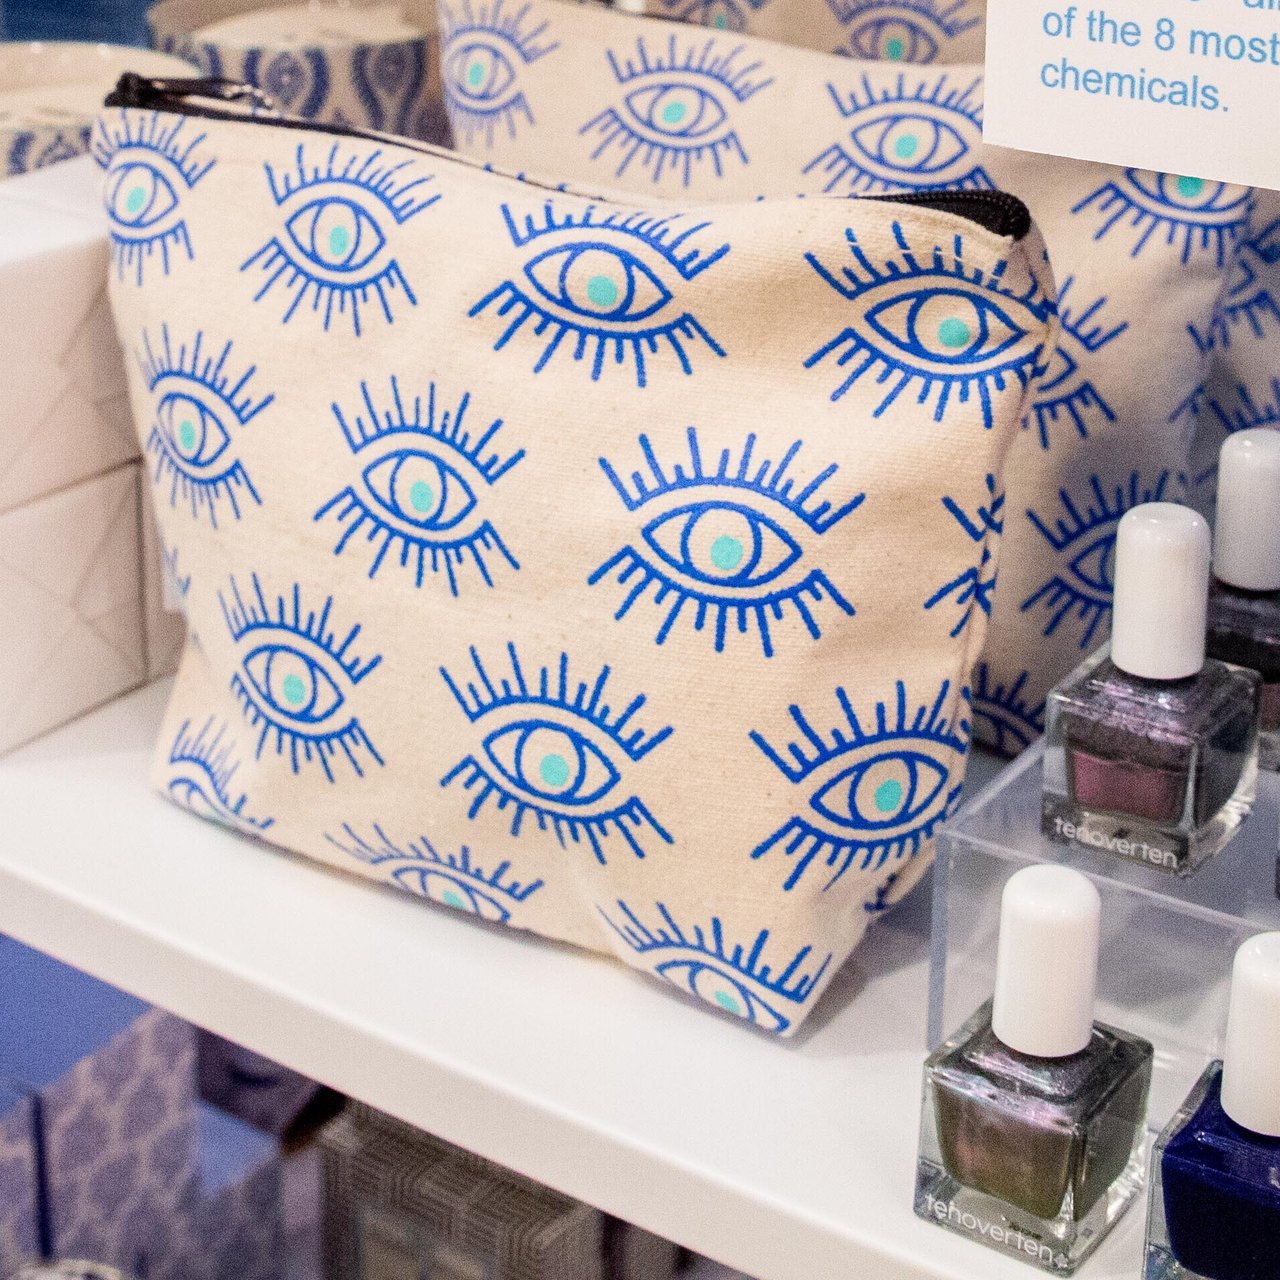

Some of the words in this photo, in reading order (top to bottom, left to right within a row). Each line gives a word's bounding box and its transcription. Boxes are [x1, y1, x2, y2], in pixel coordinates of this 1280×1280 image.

[1043, 5, 1076, 37] of
[1087, 11, 1141, 47] the
[1154, 17, 1176, 51] 8
[1189, 30, 1279, 65] most
[1041, 59, 1229, 113] chemicals.
[1054, 816, 1178, 869] tenoverten
[925, 1193, 1053, 1264] tenoverten
